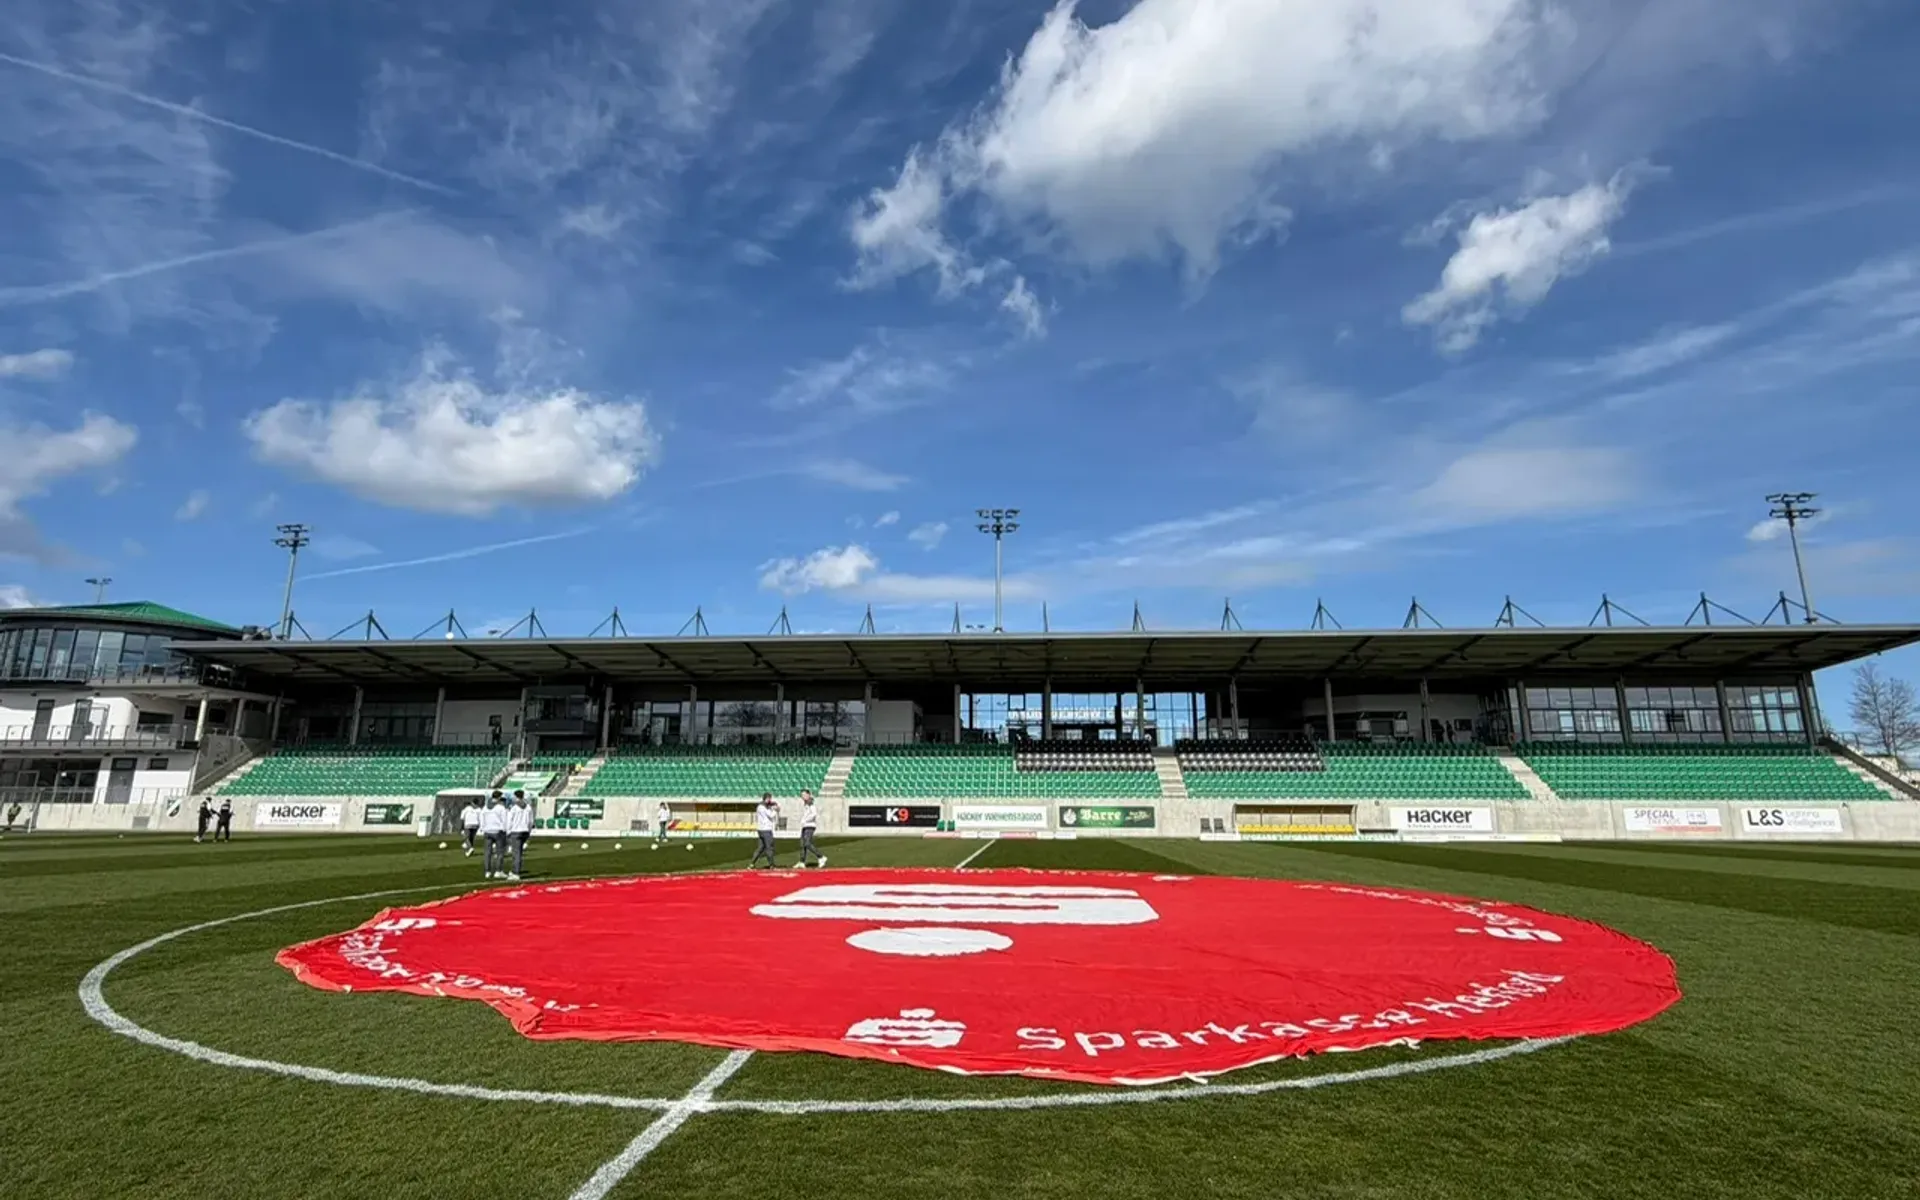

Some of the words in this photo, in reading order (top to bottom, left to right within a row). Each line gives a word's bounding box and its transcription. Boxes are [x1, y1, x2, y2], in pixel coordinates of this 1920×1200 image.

[886, 808, 909, 822] K9
[1634, 809, 1675, 819] SPECIAL
[1747, 809, 1784, 826] L&S
[1016, 1009, 1427, 1057] Sparkasse
